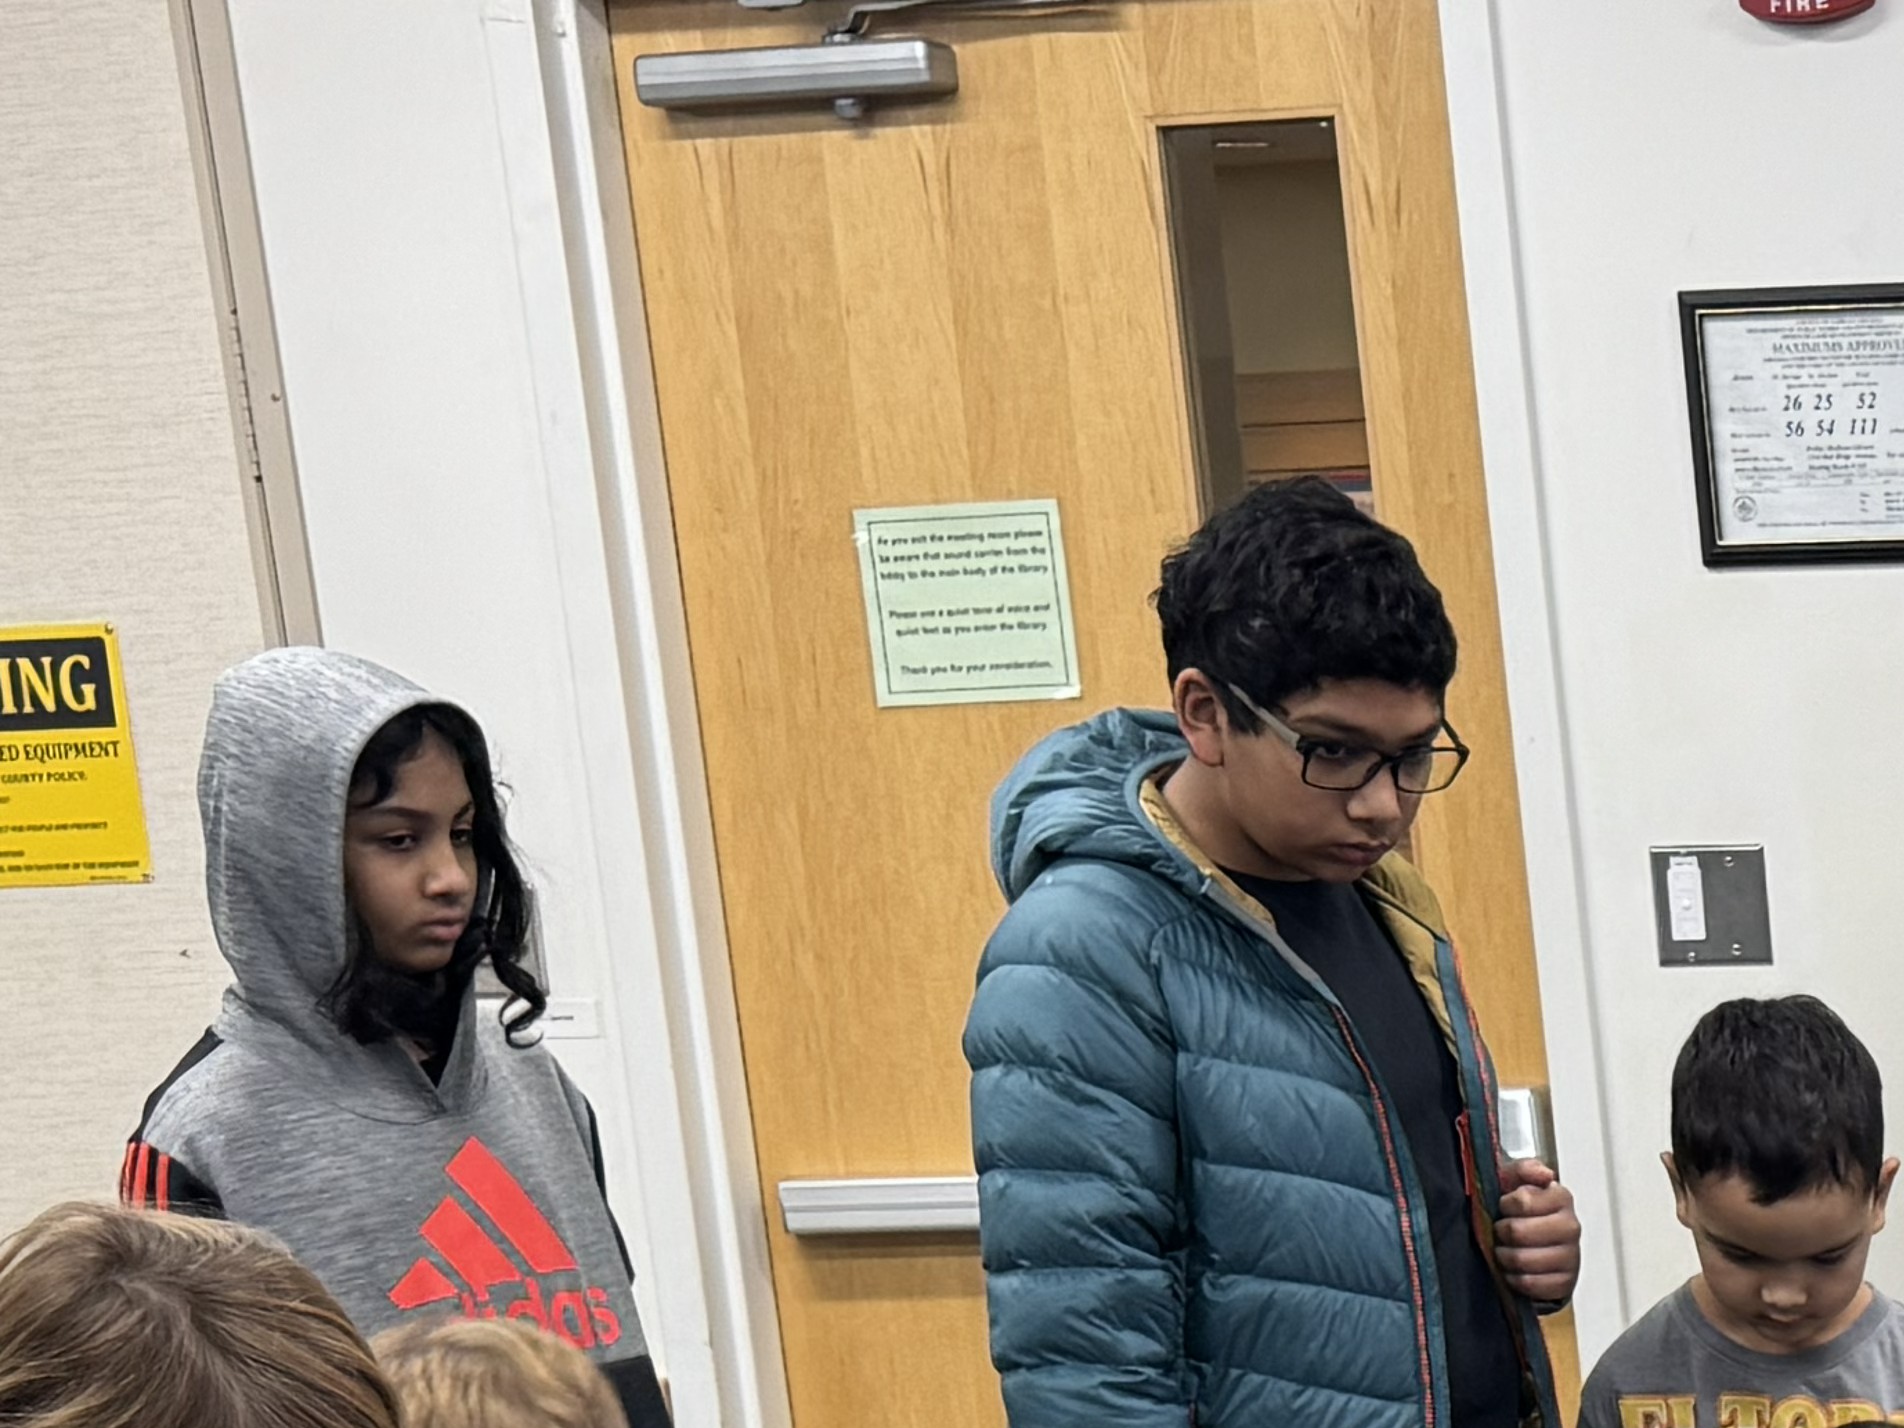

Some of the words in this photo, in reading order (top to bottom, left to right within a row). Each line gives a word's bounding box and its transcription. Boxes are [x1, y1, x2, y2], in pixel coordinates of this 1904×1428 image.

[1770, 0, 1830, 13] FIRE
[1772, 341, 1844, 354] MAXIMUMS
[1782, 394, 1803, 412] 26
[1813, 393, 1833, 411] 25
[1855, 391, 1877, 410] 52
[1785, 420, 1805, 438] 56
[1815, 419, 1836, 437] 54
[1849, 417, 1878, 436] 111
[0, 654, 97, 715] ING
[24, 740, 120, 764] EQUIPMENT
